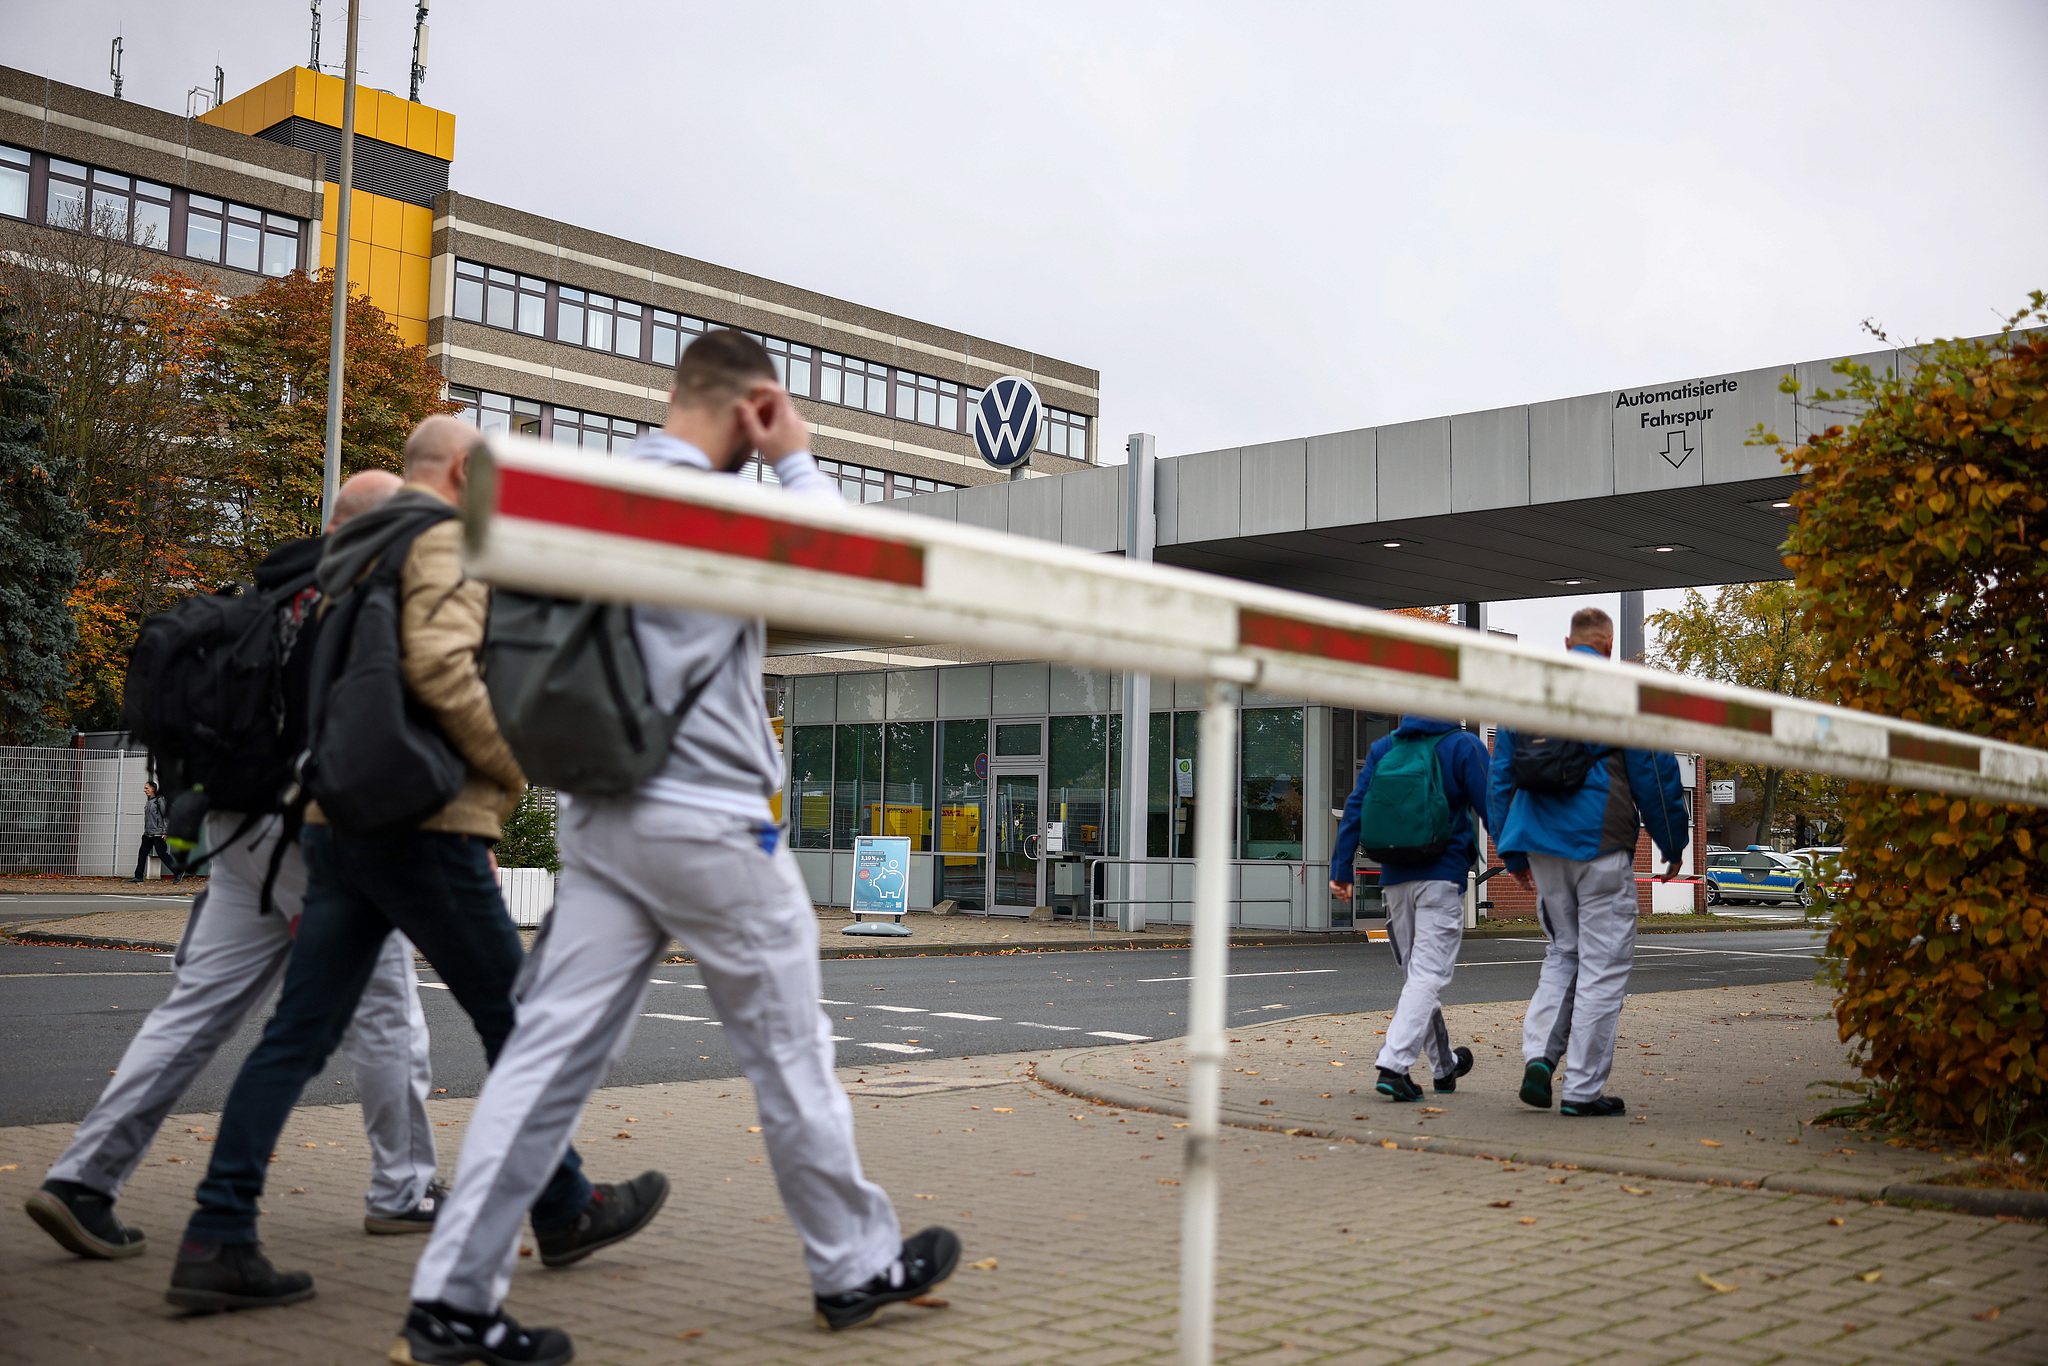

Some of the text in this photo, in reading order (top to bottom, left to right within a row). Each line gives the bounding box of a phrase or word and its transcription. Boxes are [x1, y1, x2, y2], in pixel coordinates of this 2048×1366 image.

[1616, 379, 1737, 408] Automatisierte
[977, 379, 1038, 460] VW
[1641, 408, 1713, 428] Fahrspur
